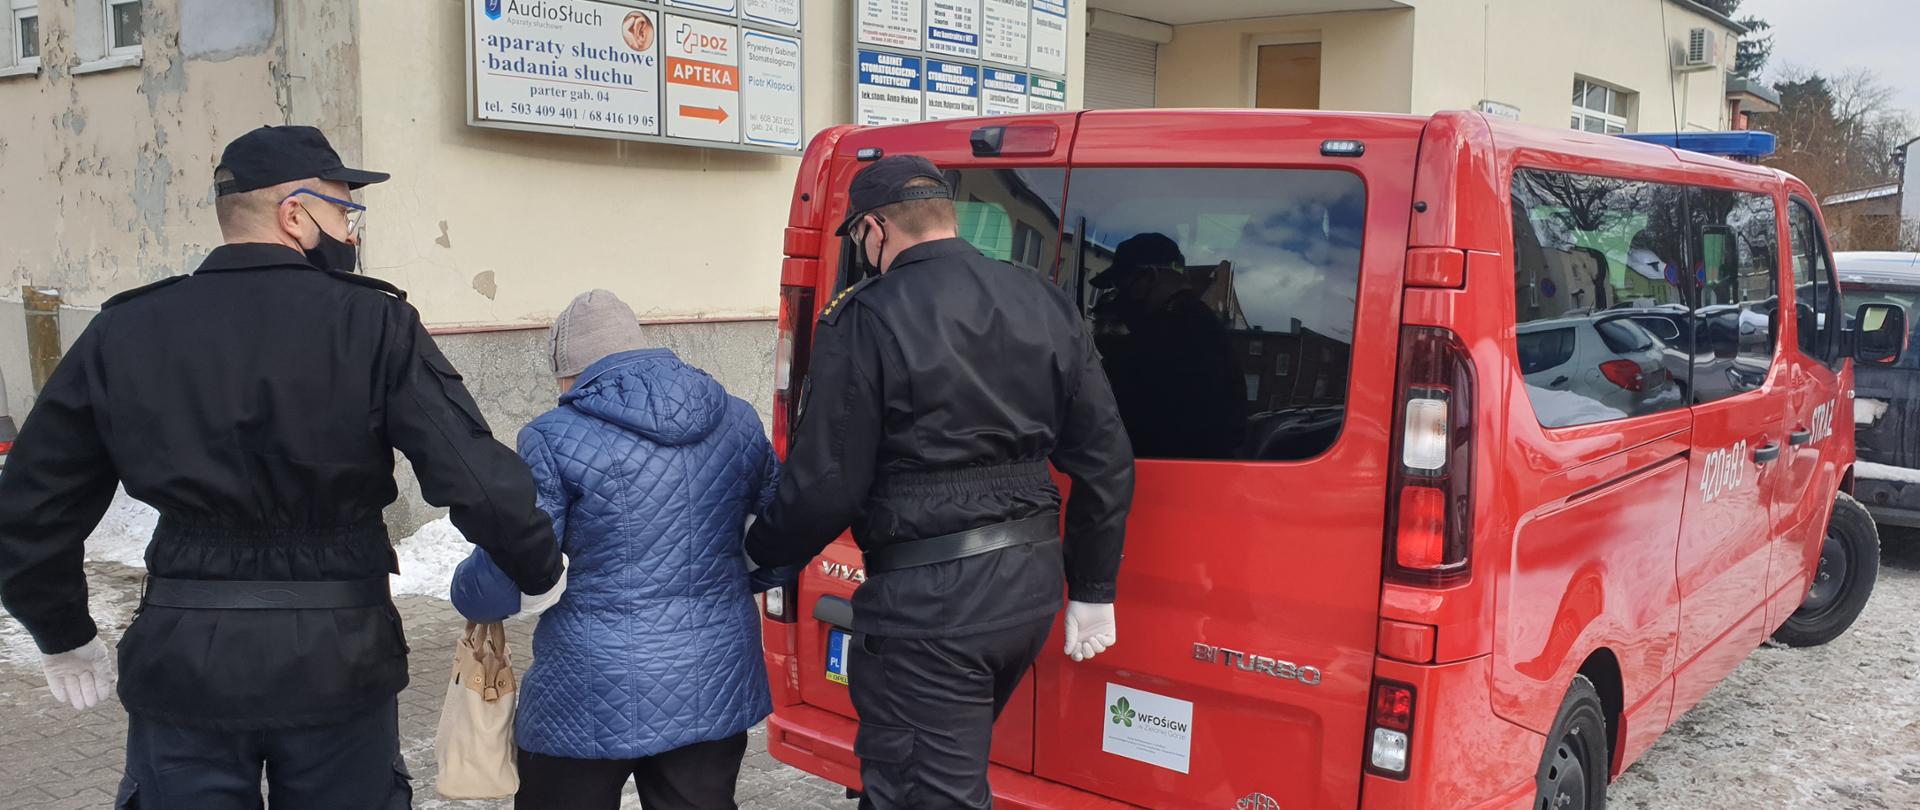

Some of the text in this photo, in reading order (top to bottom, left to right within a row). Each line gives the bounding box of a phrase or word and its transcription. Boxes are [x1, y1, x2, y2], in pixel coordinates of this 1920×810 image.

[507, 0, 602, 26] AudioSłuch
[488, 34, 654, 67] aparaty słuchowe
[701, 35, 728, 51] DOZ
[746, 41, 797, 57] Prywatny Gabinet
[748, 52, 796, 69] Stomatologiczny
[878, 55, 903, 66] GABINET
[488, 53, 633, 86] badania słuchu
[673, 63, 732, 85] APTEKA
[748, 76, 765, 87] Piotr
[871, 74, 910, 88] PROTETYCZNY
[530, 86, 610, 102] parter gab. 04
[887, 93, 900, 103] Anna
[485, 101, 503, 113] tel.
[511, 102, 532, 115] 503
[535, 105, 556, 118] 409
[559, 107, 578, 120] 401
[589, 110, 602, 122] 68
[605, 112, 624, 124] 416
[628, 113, 639, 126] 19
[642, 116, 654, 128] 05
[822, 560, 867, 583] VIVA
[830, 656, 840, 668] PL
[1193, 642, 1321, 686] BITURBO
[1138, 712, 1187, 732] WFOŚiGW
